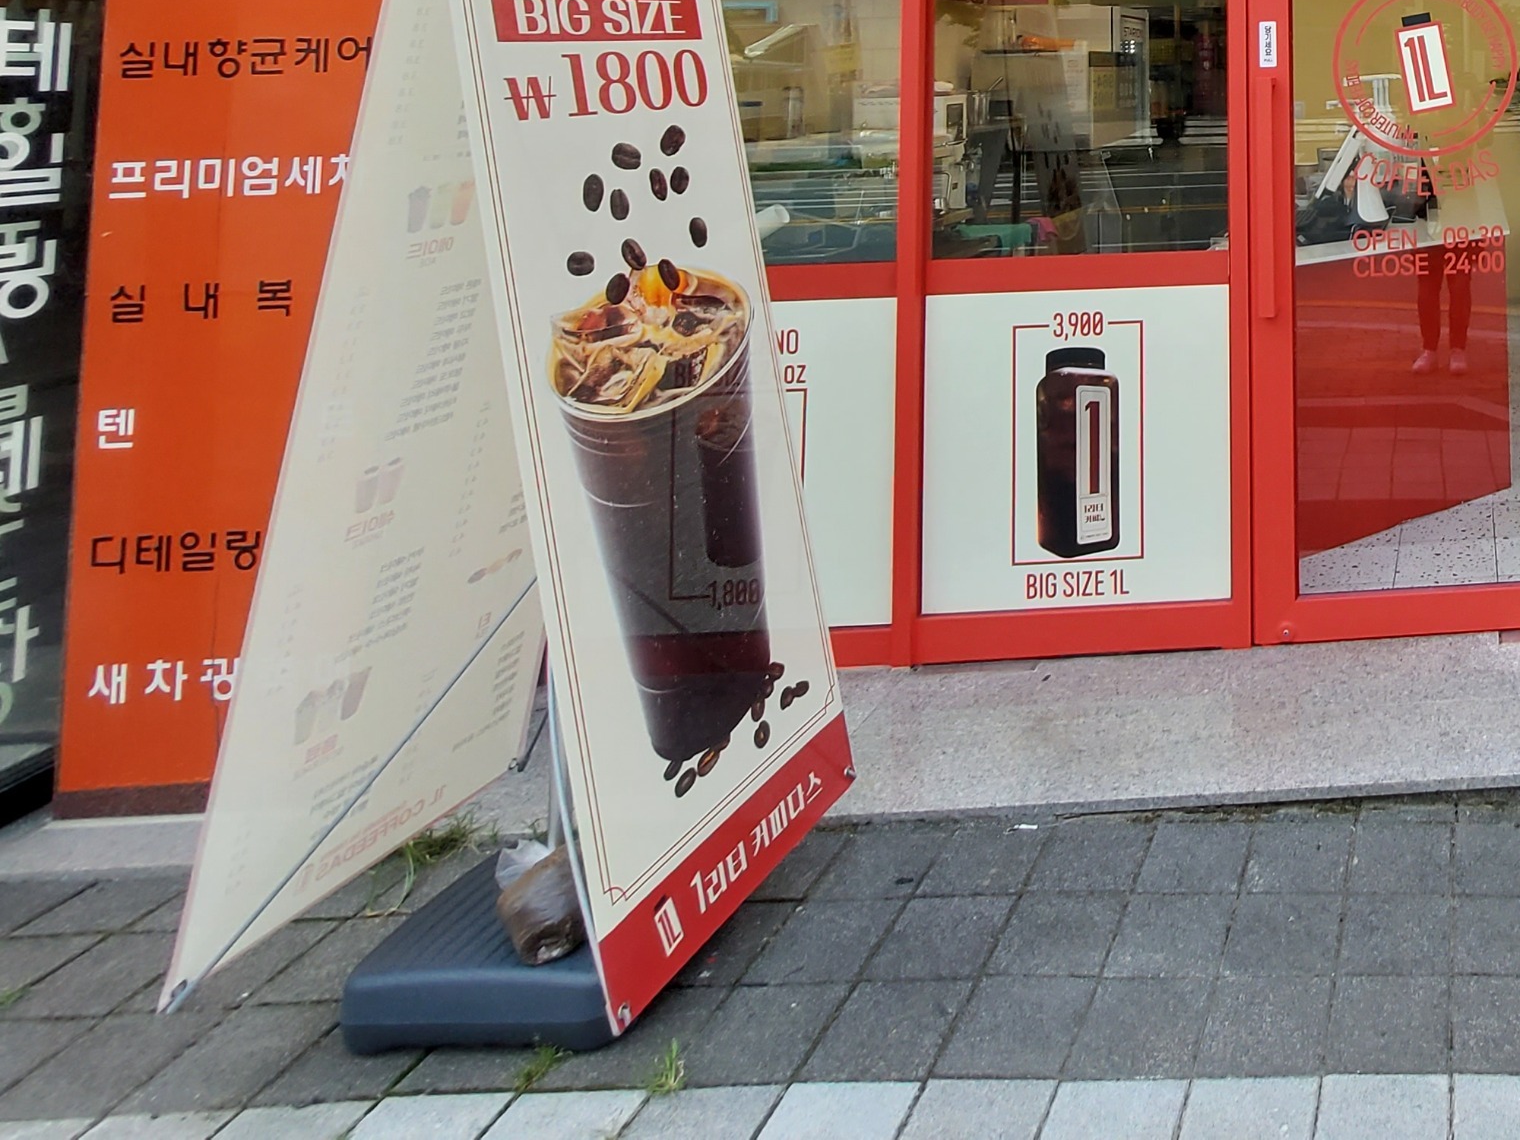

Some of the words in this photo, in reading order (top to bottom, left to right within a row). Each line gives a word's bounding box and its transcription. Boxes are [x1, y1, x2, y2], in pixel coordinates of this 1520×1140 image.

[601, 0, 687, 35] SIZE
[119, 36, 372, 80] 실내향균케어
[1353, 229, 1418, 253] OPEN
[1442, 225, 1505, 248] 09:30
[1353, 253, 1430, 278] CLOSE
[1443, 251, 1505, 275] 24:00
[1053, 311, 1104, 342] 3,900
[90, 529, 262, 575] 디테일링
[1025, 572, 1057, 600] BIG
[1063, 570, 1105, 598] SIZE
[1109, 569, 1130, 596] 1L
[689, 846, 748, 916] 1리터
[751, 770, 824, 856] 커피다스
